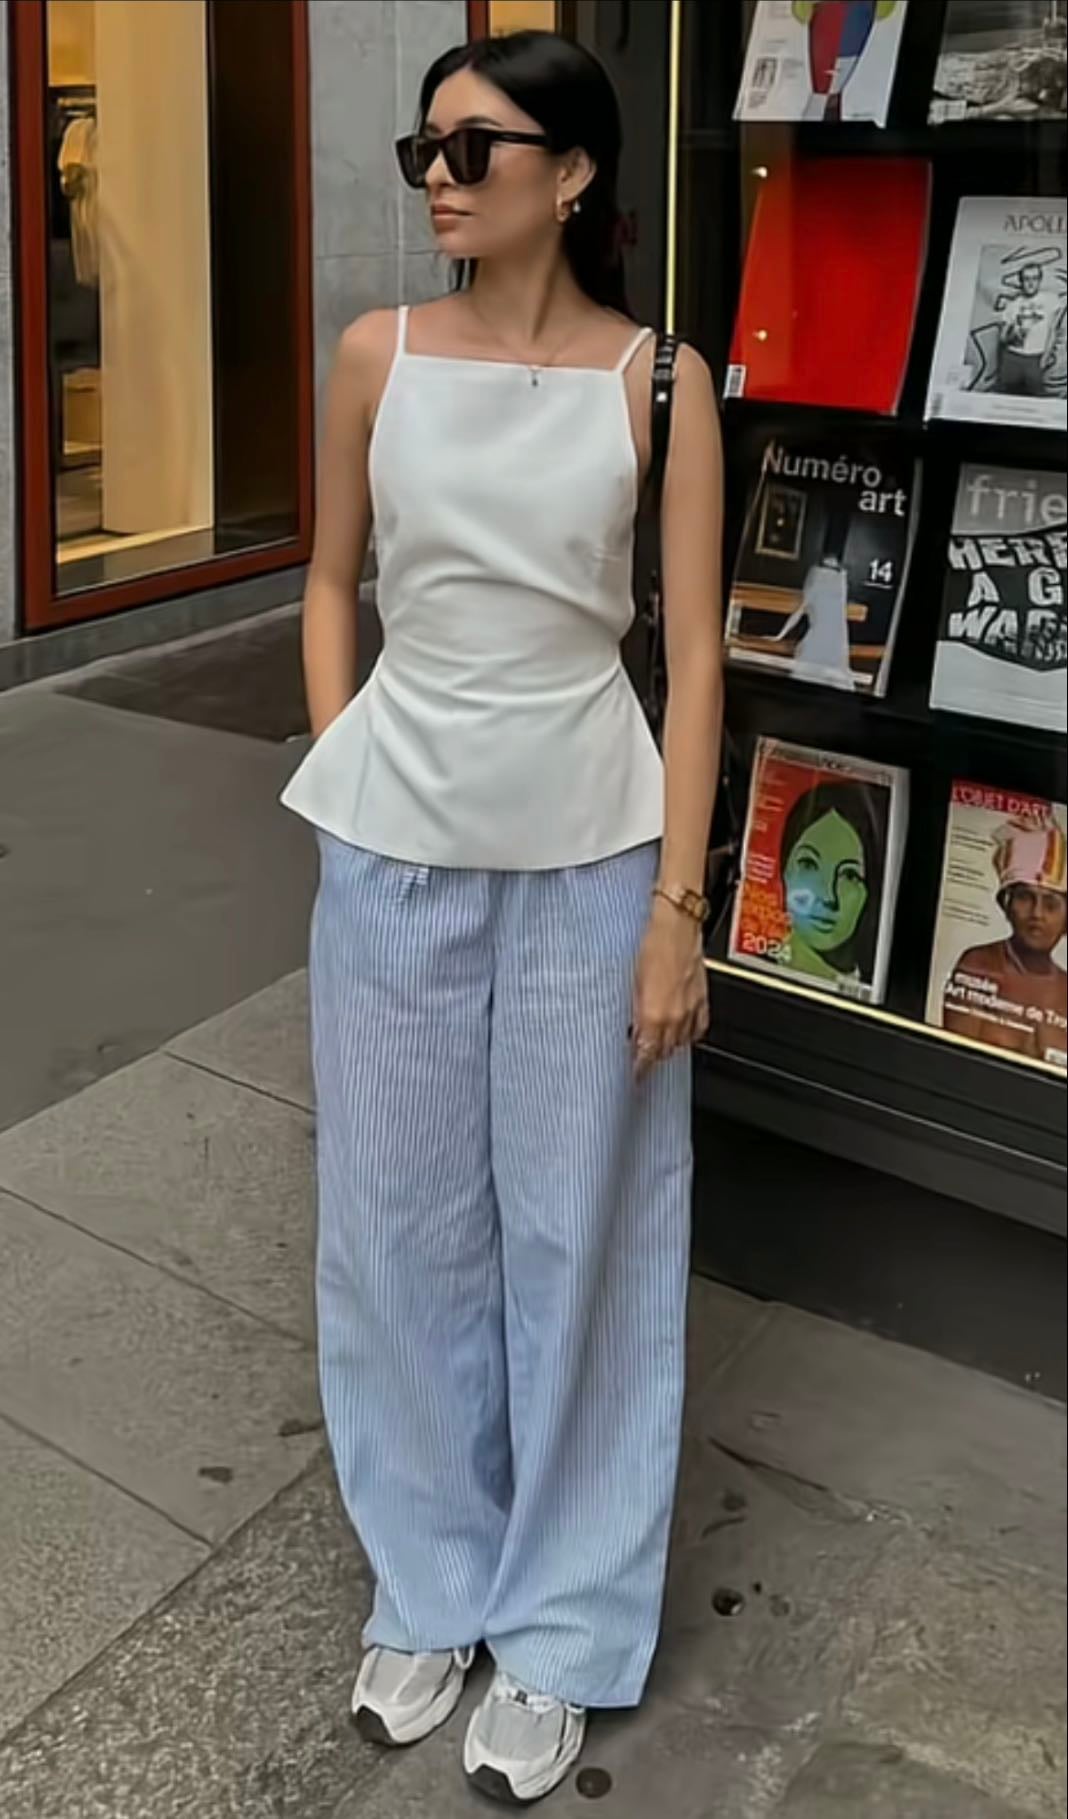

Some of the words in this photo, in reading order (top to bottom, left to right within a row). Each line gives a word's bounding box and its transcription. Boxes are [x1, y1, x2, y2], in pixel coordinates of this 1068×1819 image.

[761, 444, 882, 488] Numéro
[858, 488, 906, 517] art
[869, 558, 893, 582] 14
[967, 571, 1000, 608] A
